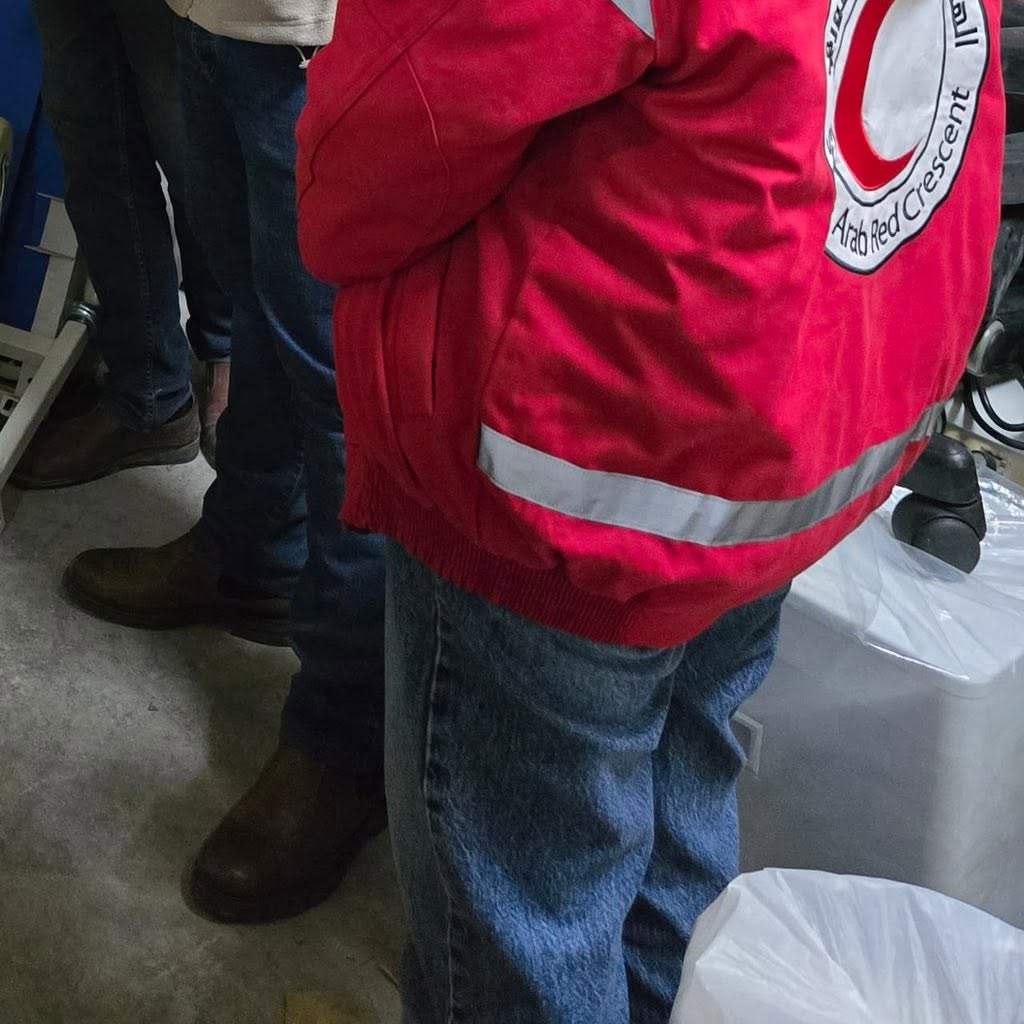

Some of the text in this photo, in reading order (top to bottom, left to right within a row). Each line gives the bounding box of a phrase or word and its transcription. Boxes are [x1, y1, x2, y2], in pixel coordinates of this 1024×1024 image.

[832, 87, 970, 256] Arab Red Crescent
